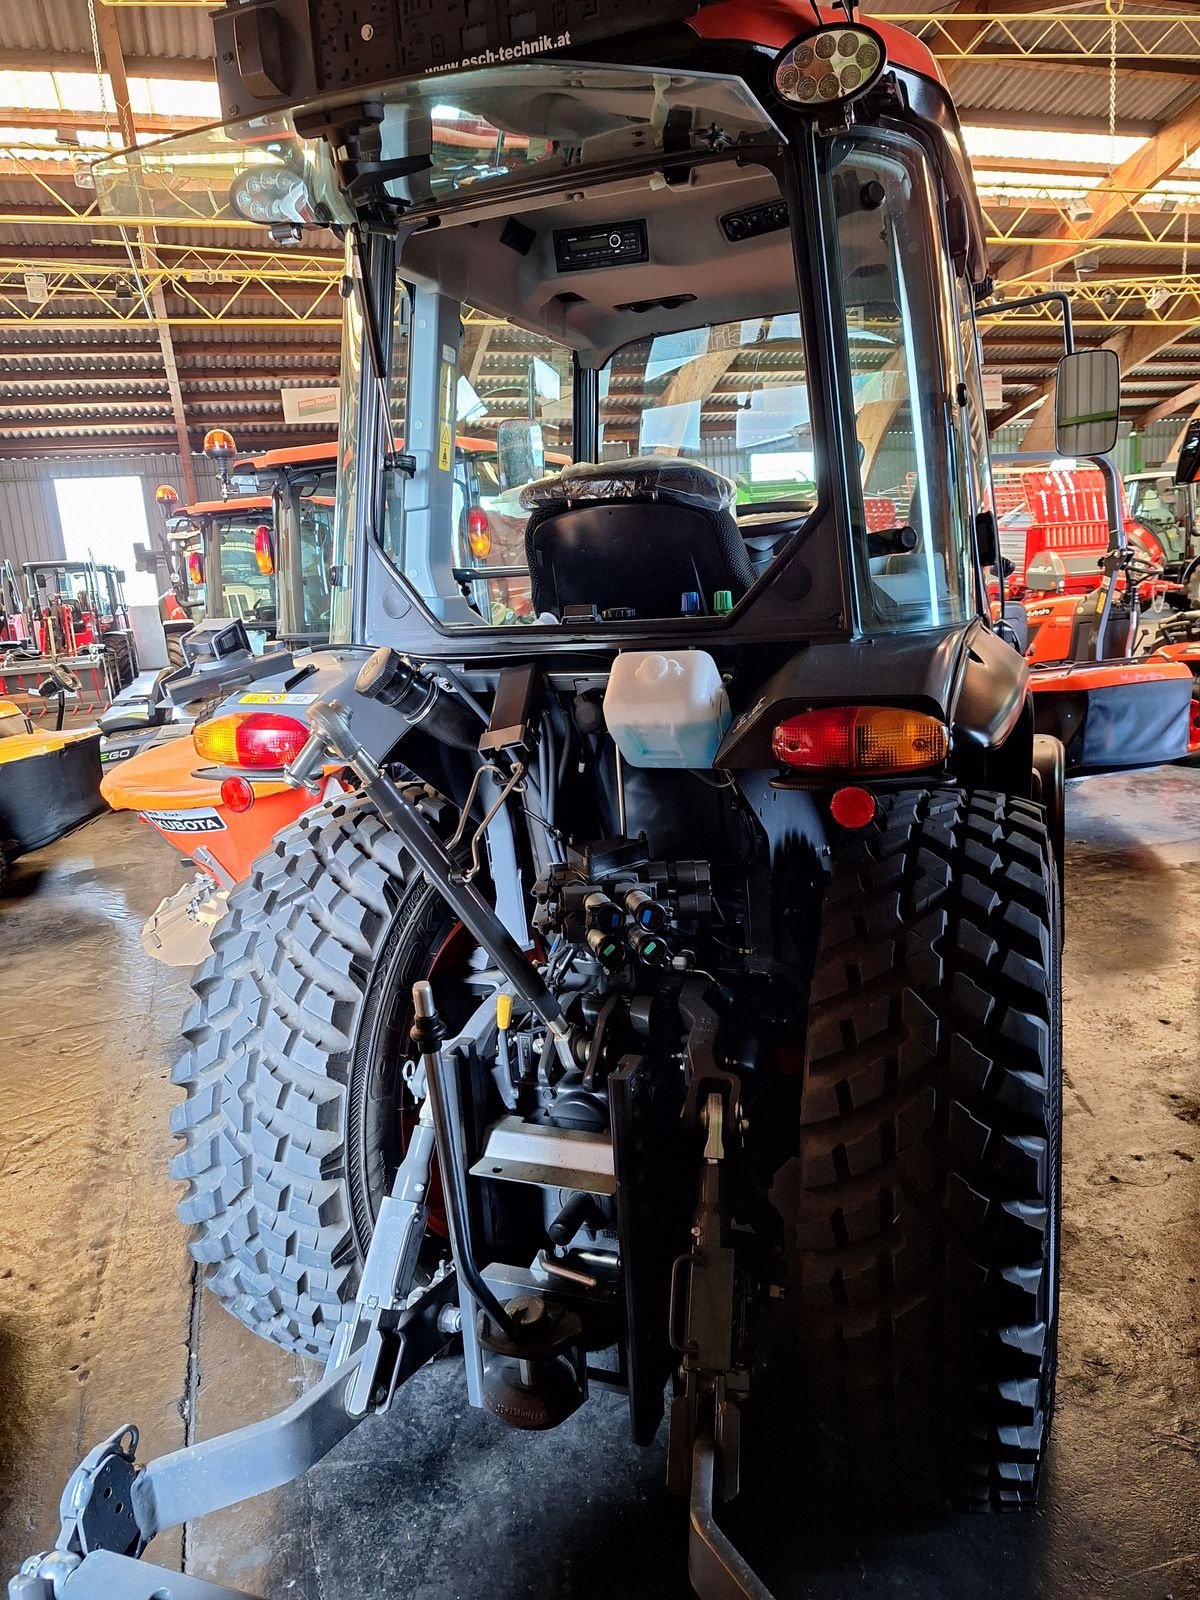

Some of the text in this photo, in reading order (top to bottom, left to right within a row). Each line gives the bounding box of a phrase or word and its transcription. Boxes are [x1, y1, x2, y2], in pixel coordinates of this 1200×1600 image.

[424, 30, 572, 74] wwwesch-technik.at
[100, 749, 130, 762] EGO
[154, 818, 220, 831] KUBOTA
